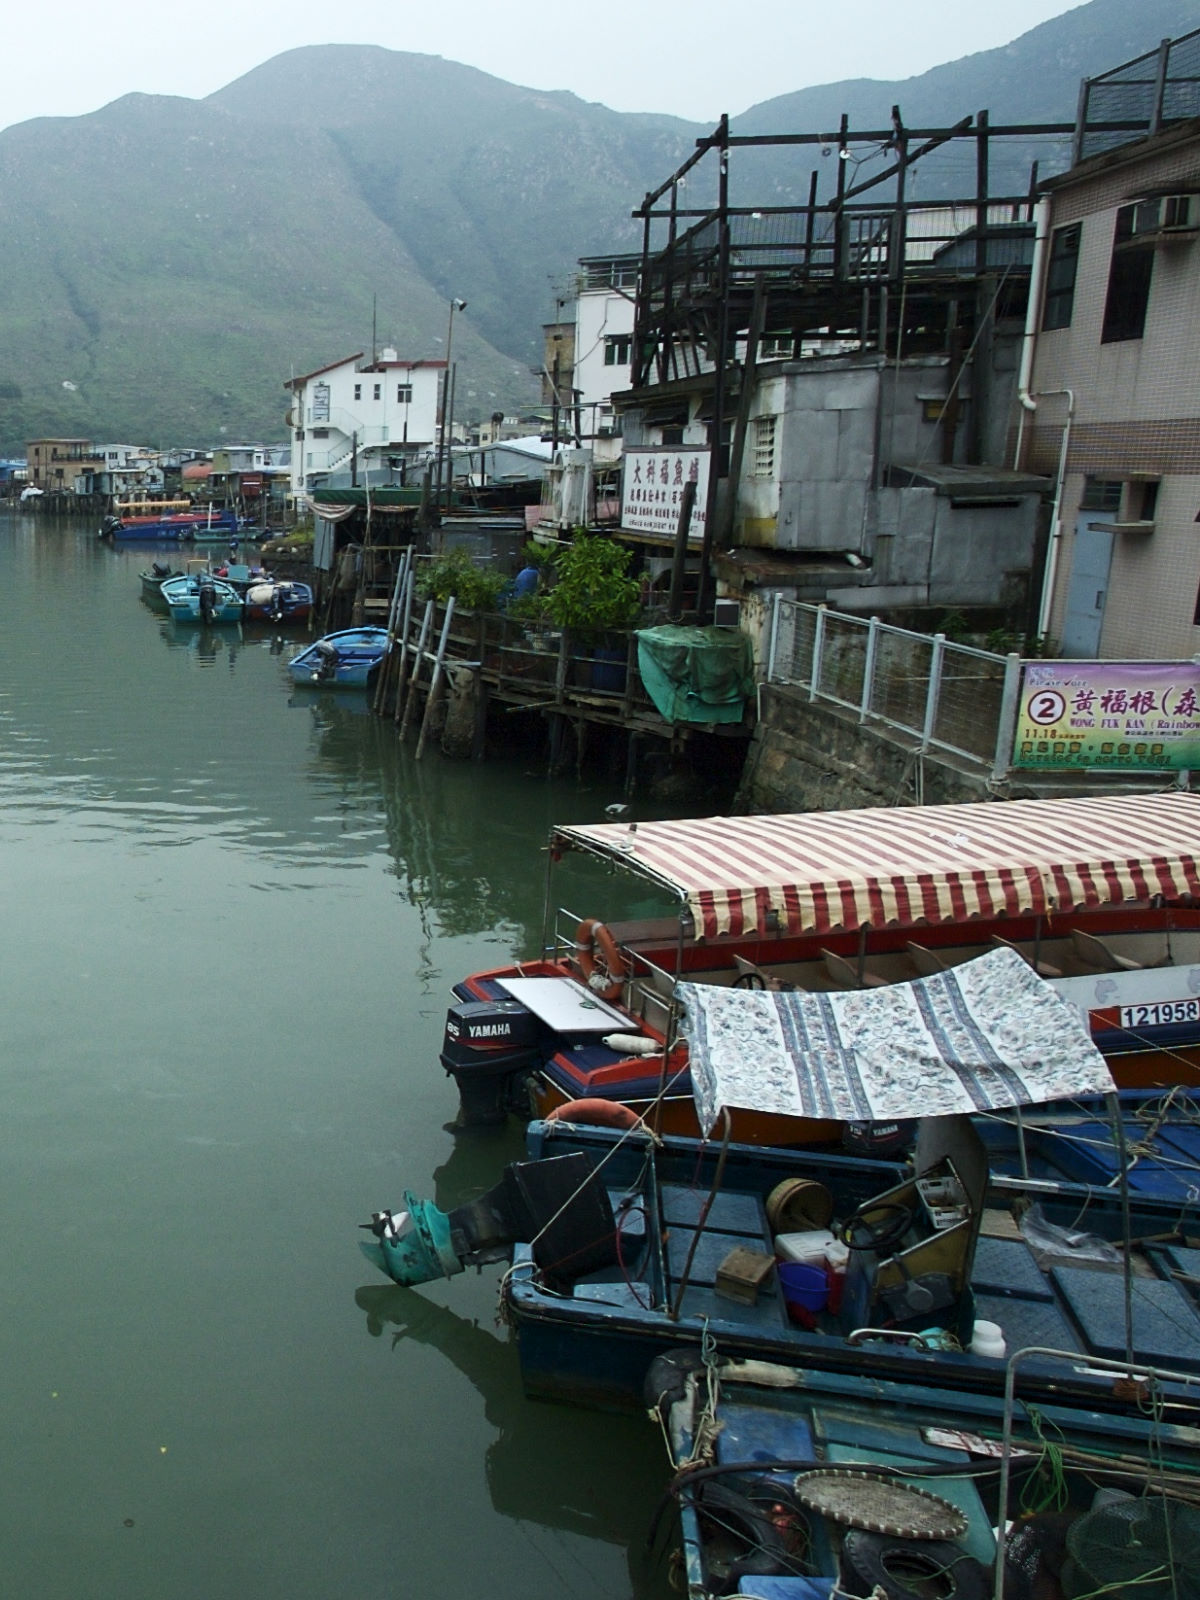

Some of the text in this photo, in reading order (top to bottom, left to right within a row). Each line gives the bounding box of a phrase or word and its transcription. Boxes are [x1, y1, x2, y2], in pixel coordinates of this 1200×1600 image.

[1069, 718, 1096, 729] WONG
[1101, 718, 1120, 729] FUK
[1126, 718, 1146, 730] KAN
[1025, 728, 1057, 740] 11.18
[1123, 1001, 1198, 1027] 121958
[469, 1023, 512, 1038] YAMAHA
